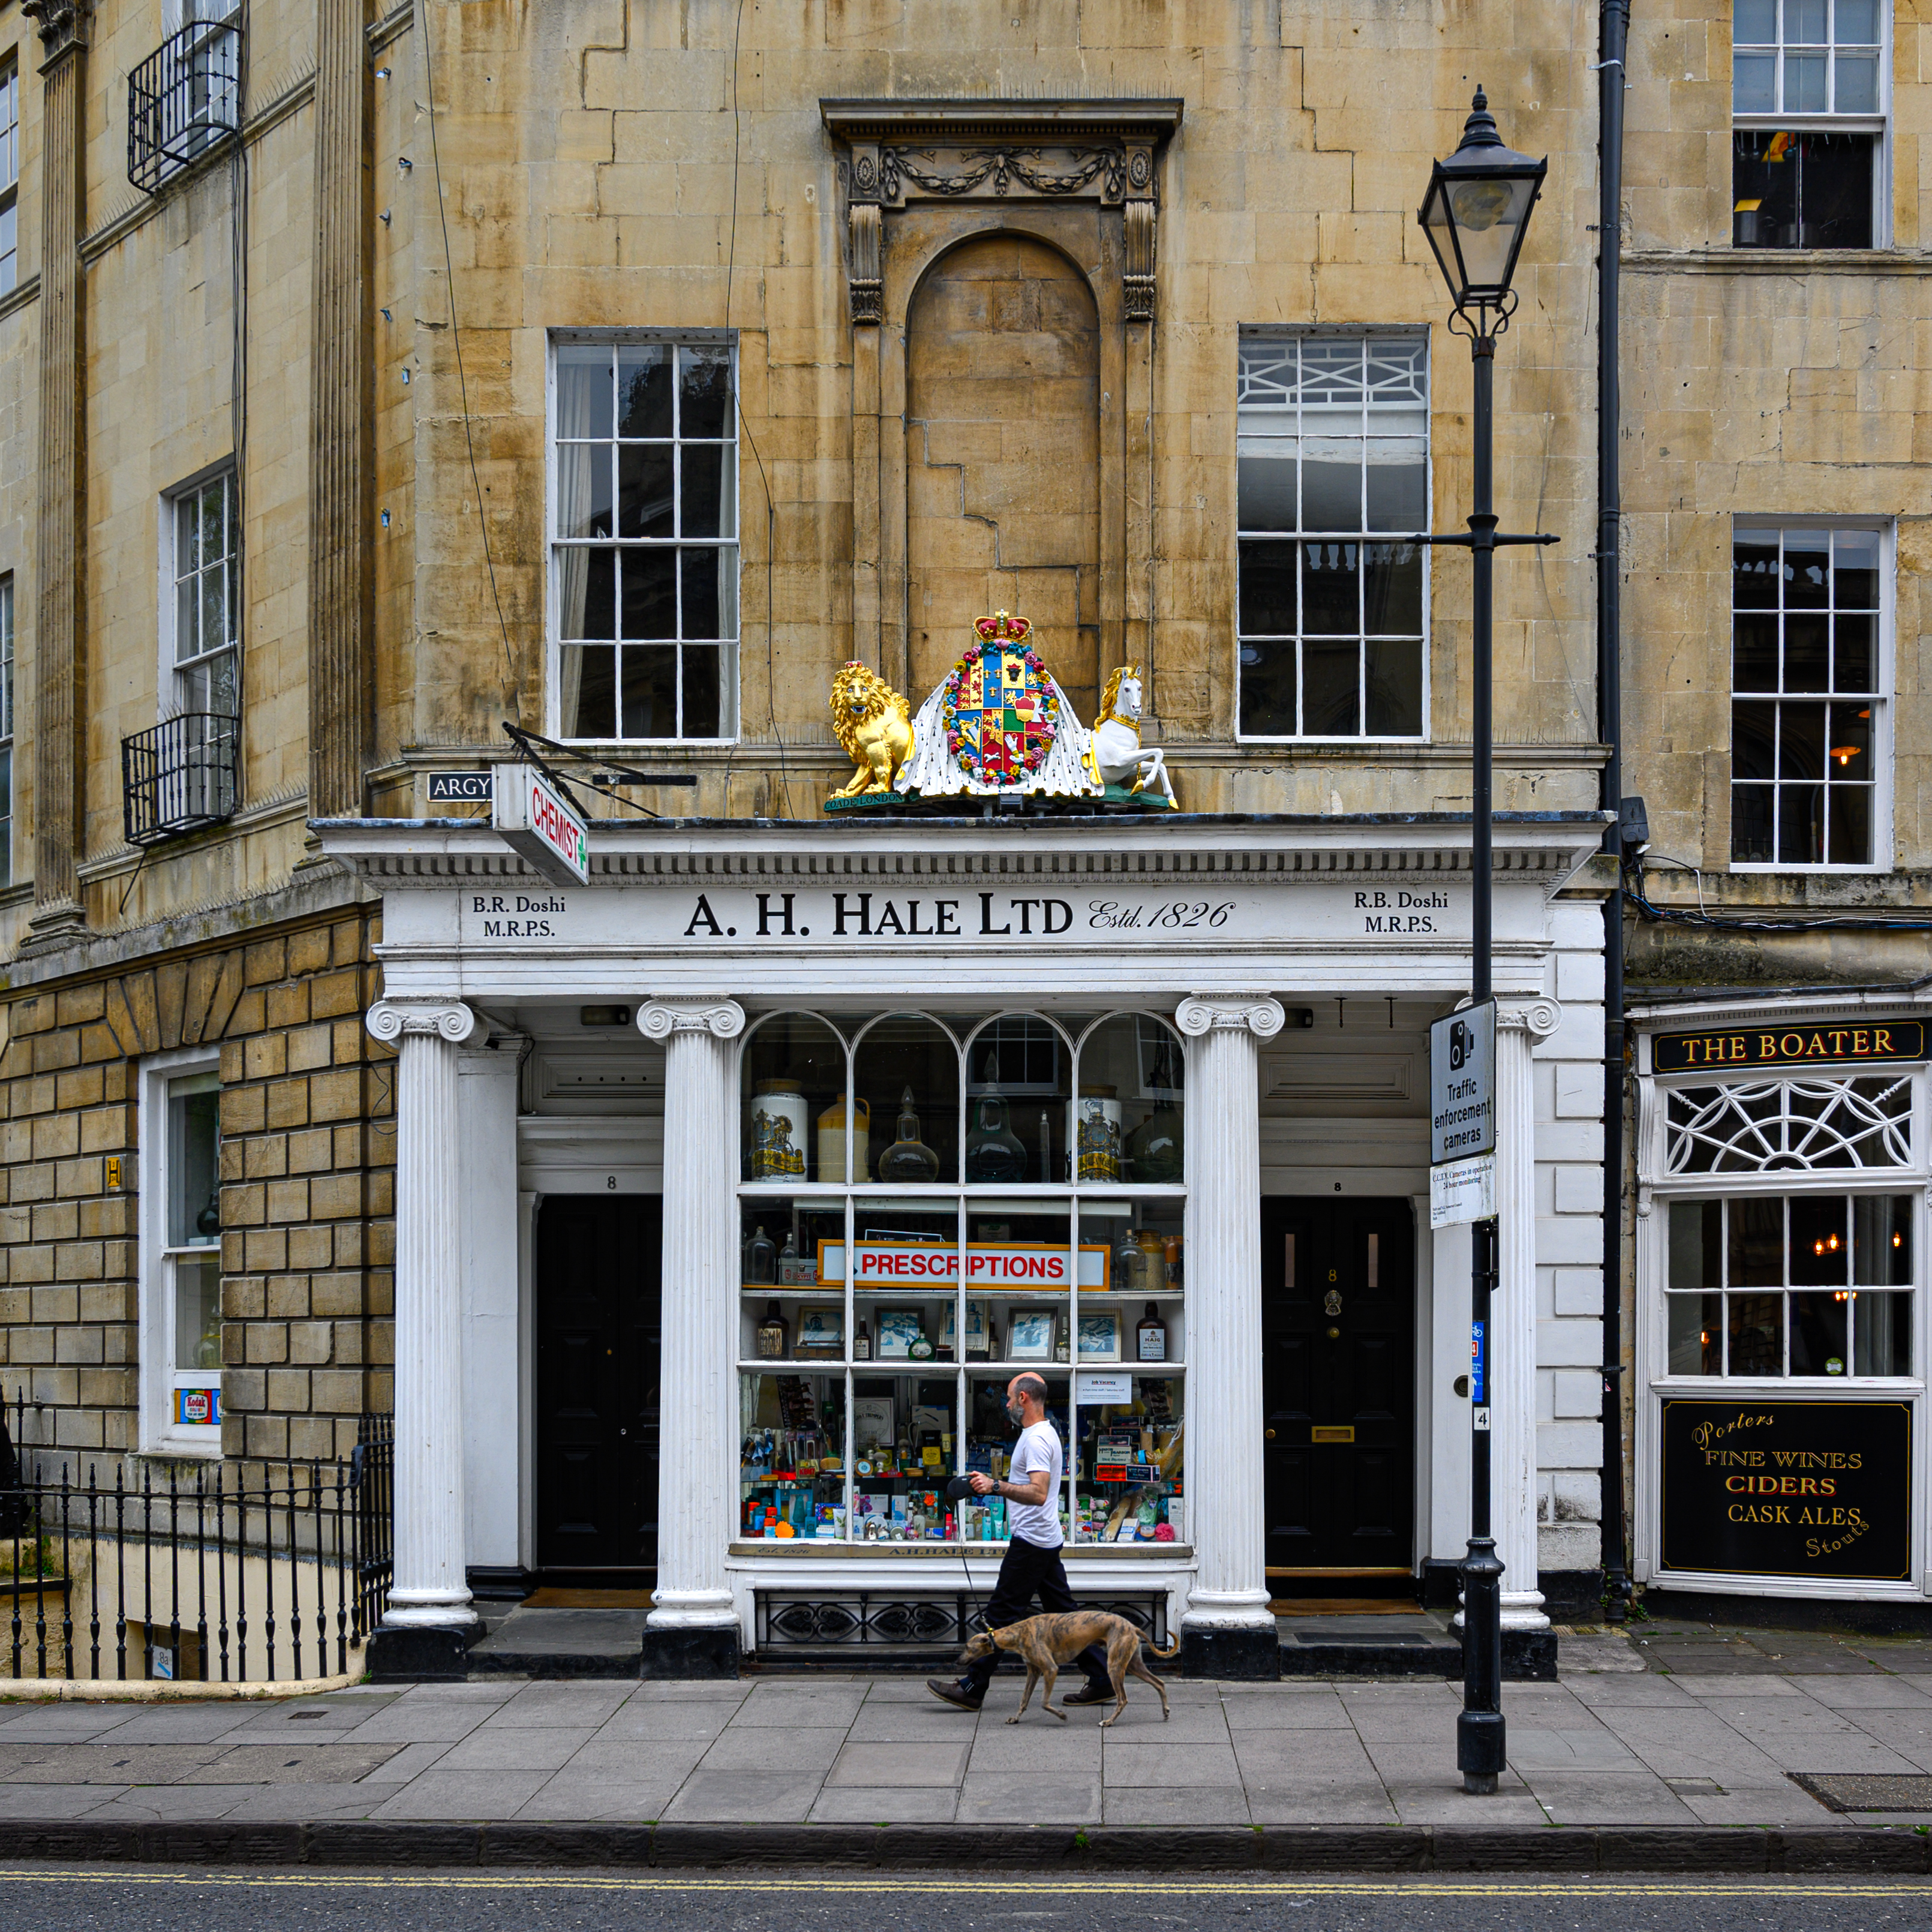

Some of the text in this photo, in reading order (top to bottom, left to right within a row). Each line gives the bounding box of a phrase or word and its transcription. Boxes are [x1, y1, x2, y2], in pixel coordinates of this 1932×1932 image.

[825, 794, 903, 810] COADE LONDON
[533, 786, 578, 864] CHEMIST
[473, 896, 566, 912] B.R. Doshi
[1354, 892, 1449, 908] R.B. Doshi
[684, 892, 1073, 937] A. H. HALE LTD
[1089, 900, 1236, 928] Estd. 1826
[484, 921, 555, 936] M.R.P.S.
[1365, 917, 1437, 932] M.R.P.S.
[1682, 1029, 1896, 1063] THE BOATER
[1447, 1078, 1477, 1102] Traffic
[1434, 1096, 1491, 1129] enforcement
[1443, 1126, 1482, 1150] cameras
[607, 1176, 616, 1189] 8
[1334, 1182, 1341, 1191] 8
[862, 1254, 1064, 1278] PRESCRIPTIONS
[1329, 1269, 1337, 1281] 8
[187, 1397, 205, 1408] Kodak
[1478, 1413, 1487, 1425] 4
[1691, 1413, 1775, 1450] Porters
[1705, 1450, 1862, 1468] FINE WINES
[1725, 1476, 1837, 1496] CIDERS
[1728, 1504, 1861, 1525] CASK ALES
[1805, 1519, 1869, 1557] Stouts
[159, 1651, 169, 1666] 8a
